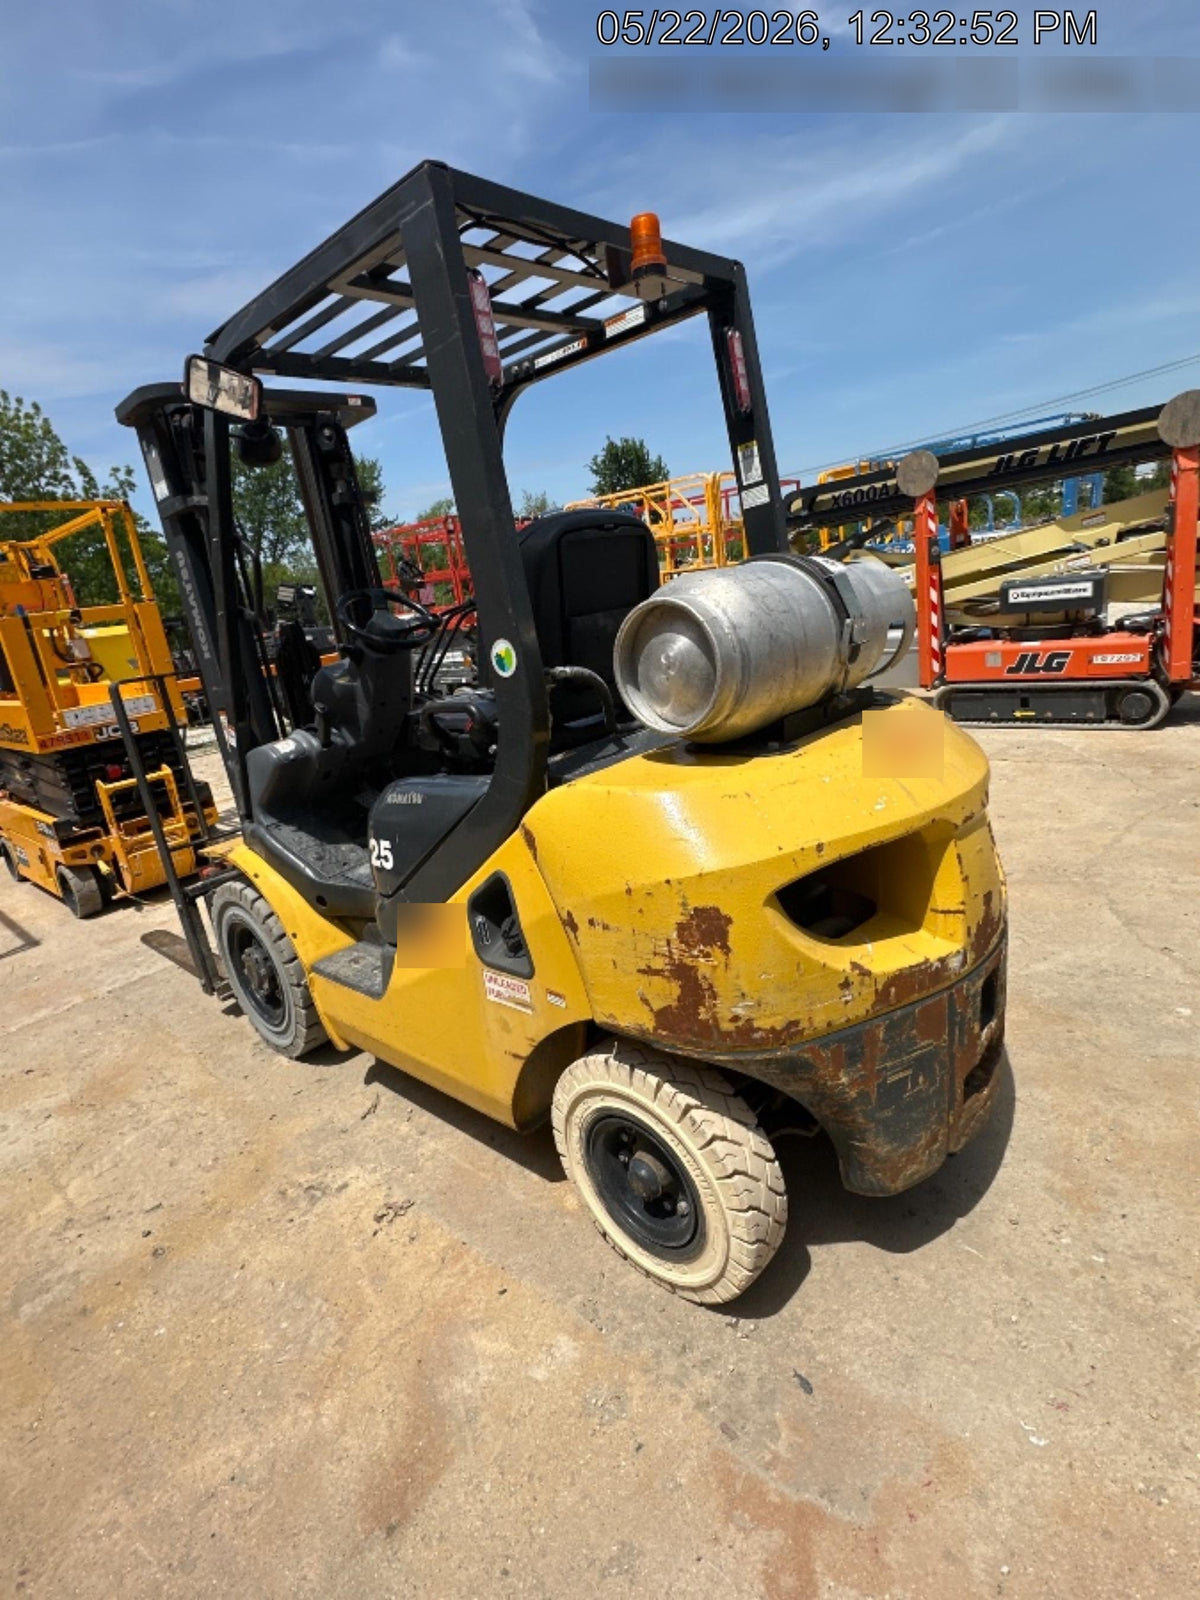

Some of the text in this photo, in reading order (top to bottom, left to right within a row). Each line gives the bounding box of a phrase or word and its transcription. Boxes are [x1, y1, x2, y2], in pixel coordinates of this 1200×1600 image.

[1047, 430, 1118, 465] LIFT
[1005, 651, 1073, 675] JLG
[369, 838, 394, 870] 25
